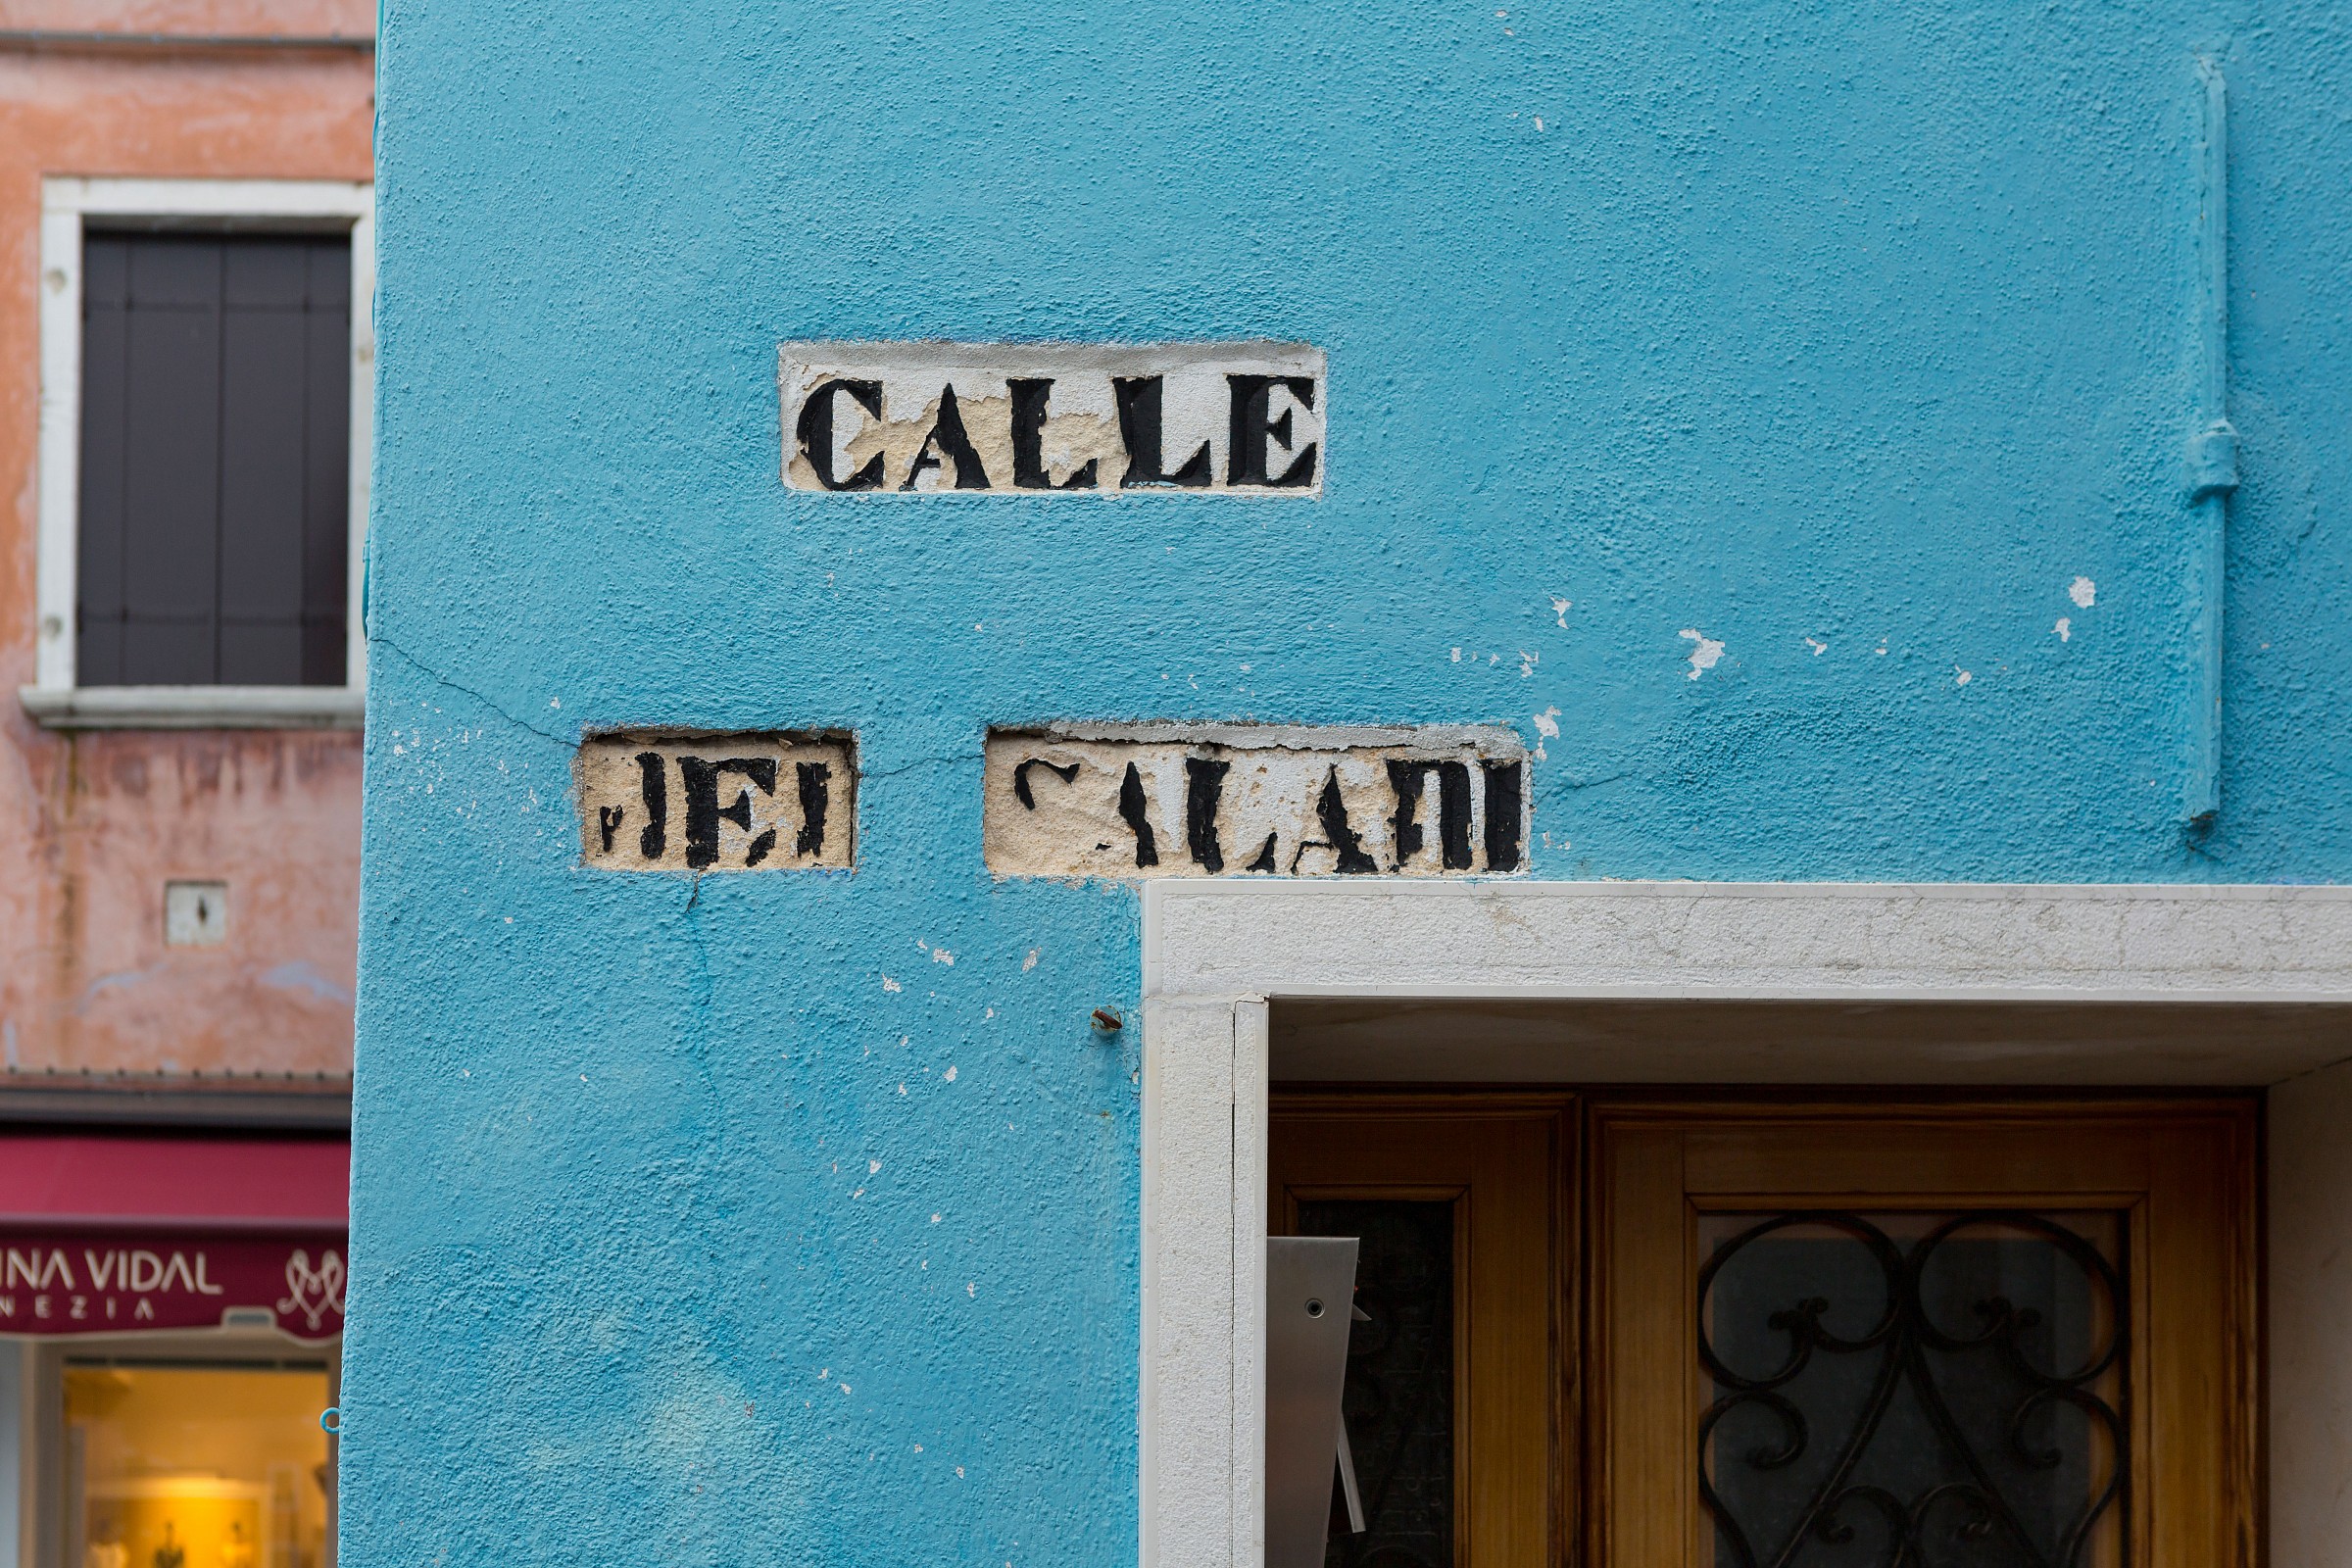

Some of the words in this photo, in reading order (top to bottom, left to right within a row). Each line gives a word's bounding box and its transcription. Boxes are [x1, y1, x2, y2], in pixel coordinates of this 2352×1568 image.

[796, 374, 1315, 490] CALLE
[0, 1248, 75, 1291] NA
[84, 1249, 223, 1296] VIDAL
